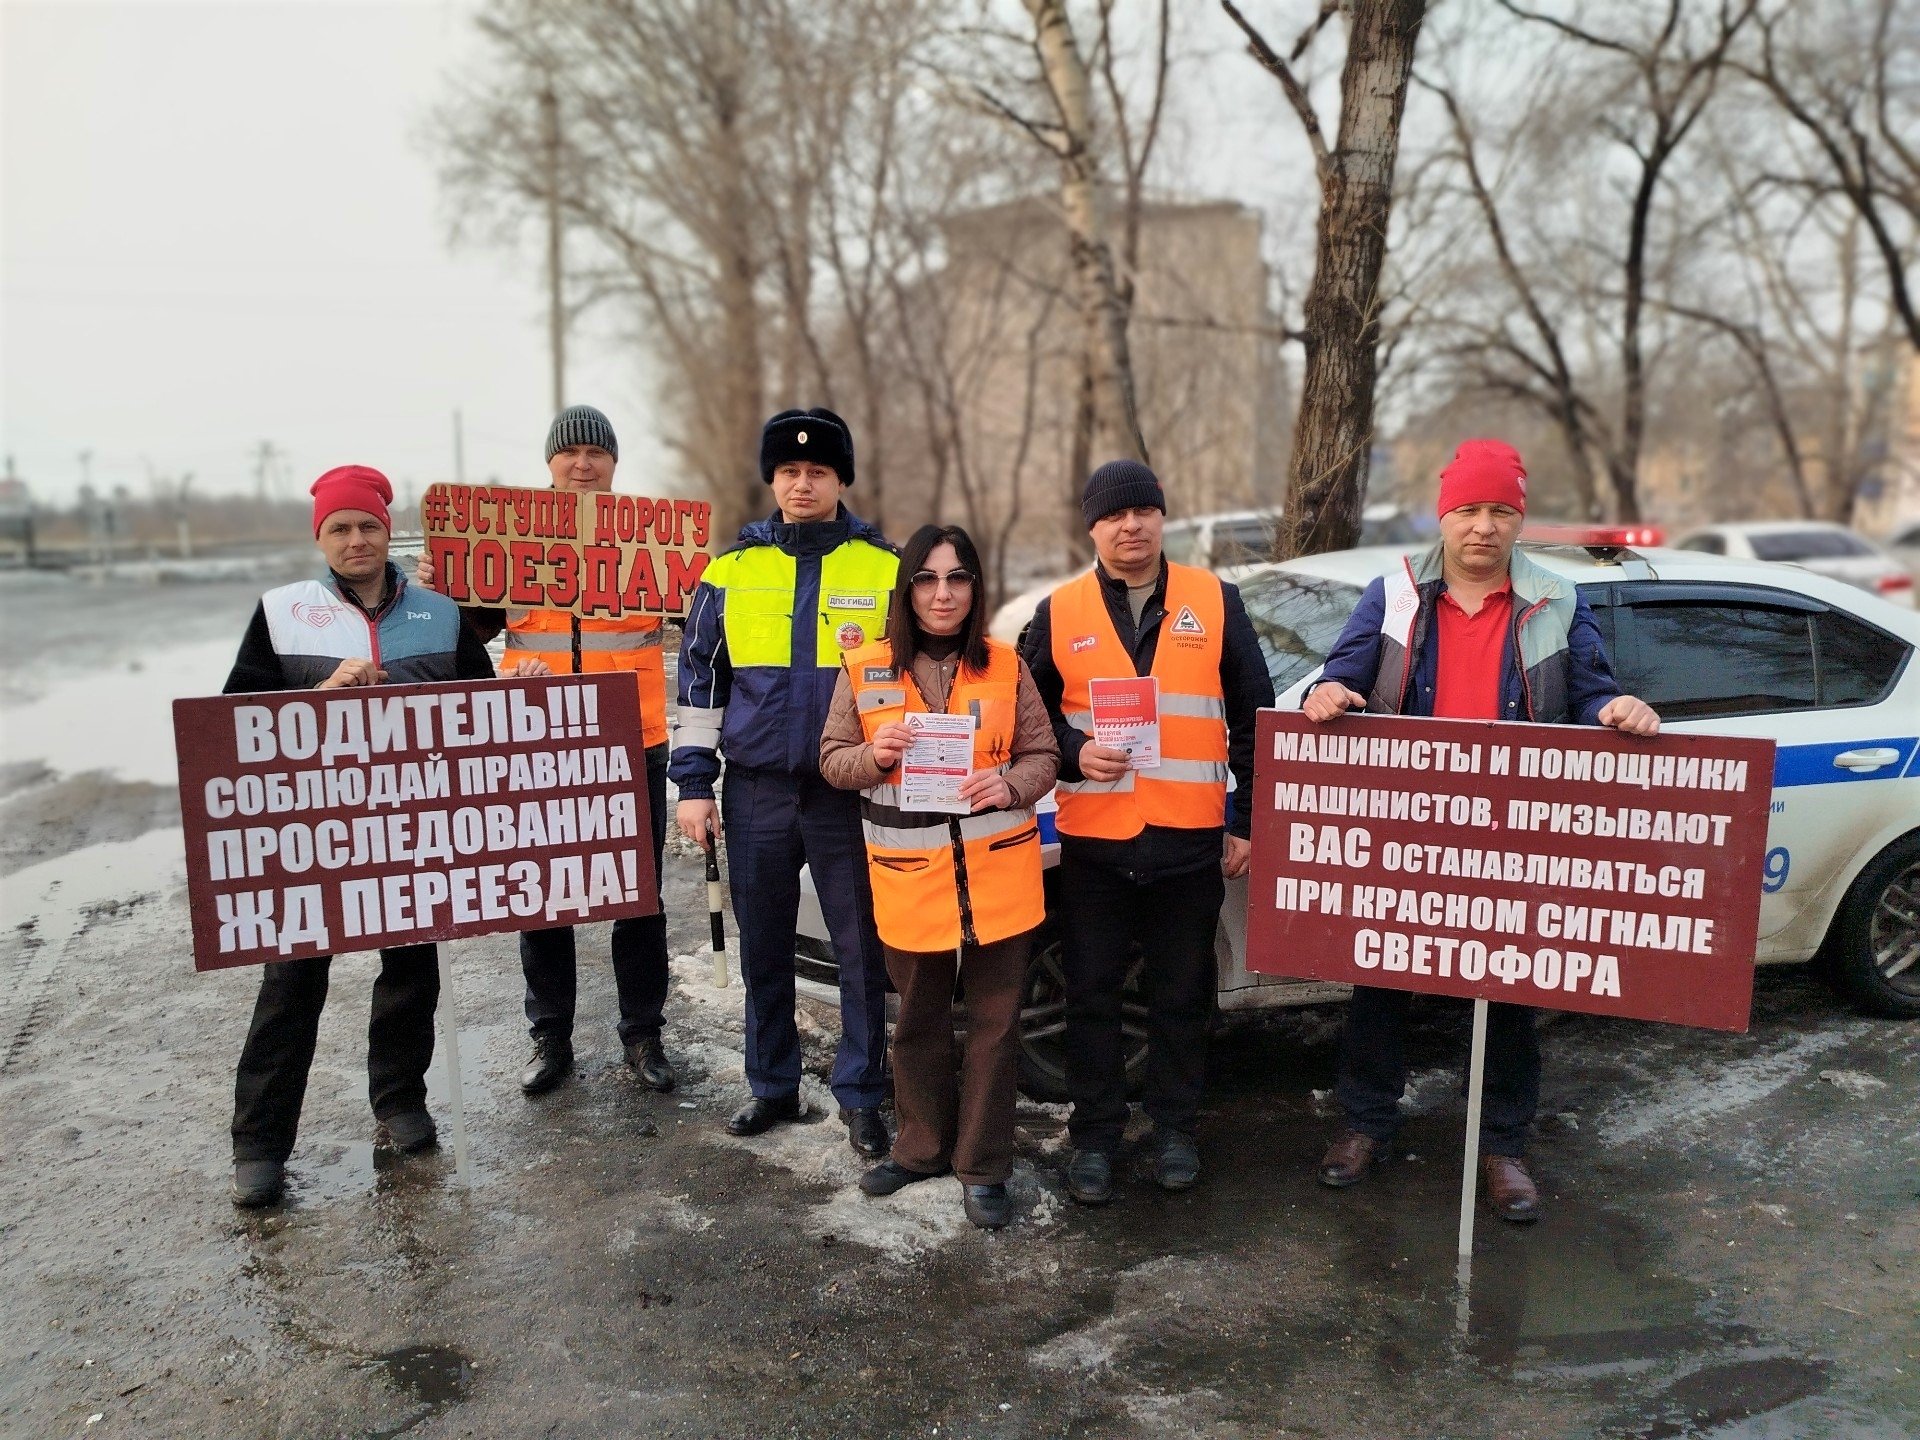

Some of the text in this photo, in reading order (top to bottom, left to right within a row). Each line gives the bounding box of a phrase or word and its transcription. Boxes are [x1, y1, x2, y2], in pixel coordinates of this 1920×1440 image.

[426, 485, 711, 547] #УСТУПИ ДОРОГУ
[429, 536, 710, 617] ПОЕЗДАМ
[830, 597, 874, 606] ДПС ГИБДД
[234, 684, 599, 766] ВОДИТЕЛЬ!!!
[1274, 732, 1747, 791] МАШИНИСТЫ И ПОМОЩНИКИ
[205, 746, 632, 818] СОБЛЮДАЙ ПРАВИЛА
[1275, 782, 1731, 846] МАШИНИСТОВ, ПРИЗЫВАЮТ
[207, 793, 637, 880] ПРОСЛЕДОВАНИЯ
[1290, 823, 1705, 899] ВАС ОСТАНАВЛИВАТЬСЯ
[216, 850, 638, 955] ЖД ПЕРЕЕЗДА!
[1276, 877, 1713, 954] ПРИ КРАСНОМ СИГНАЛЕ
[1355, 929, 1620, 997] СВЕТОФОРА
